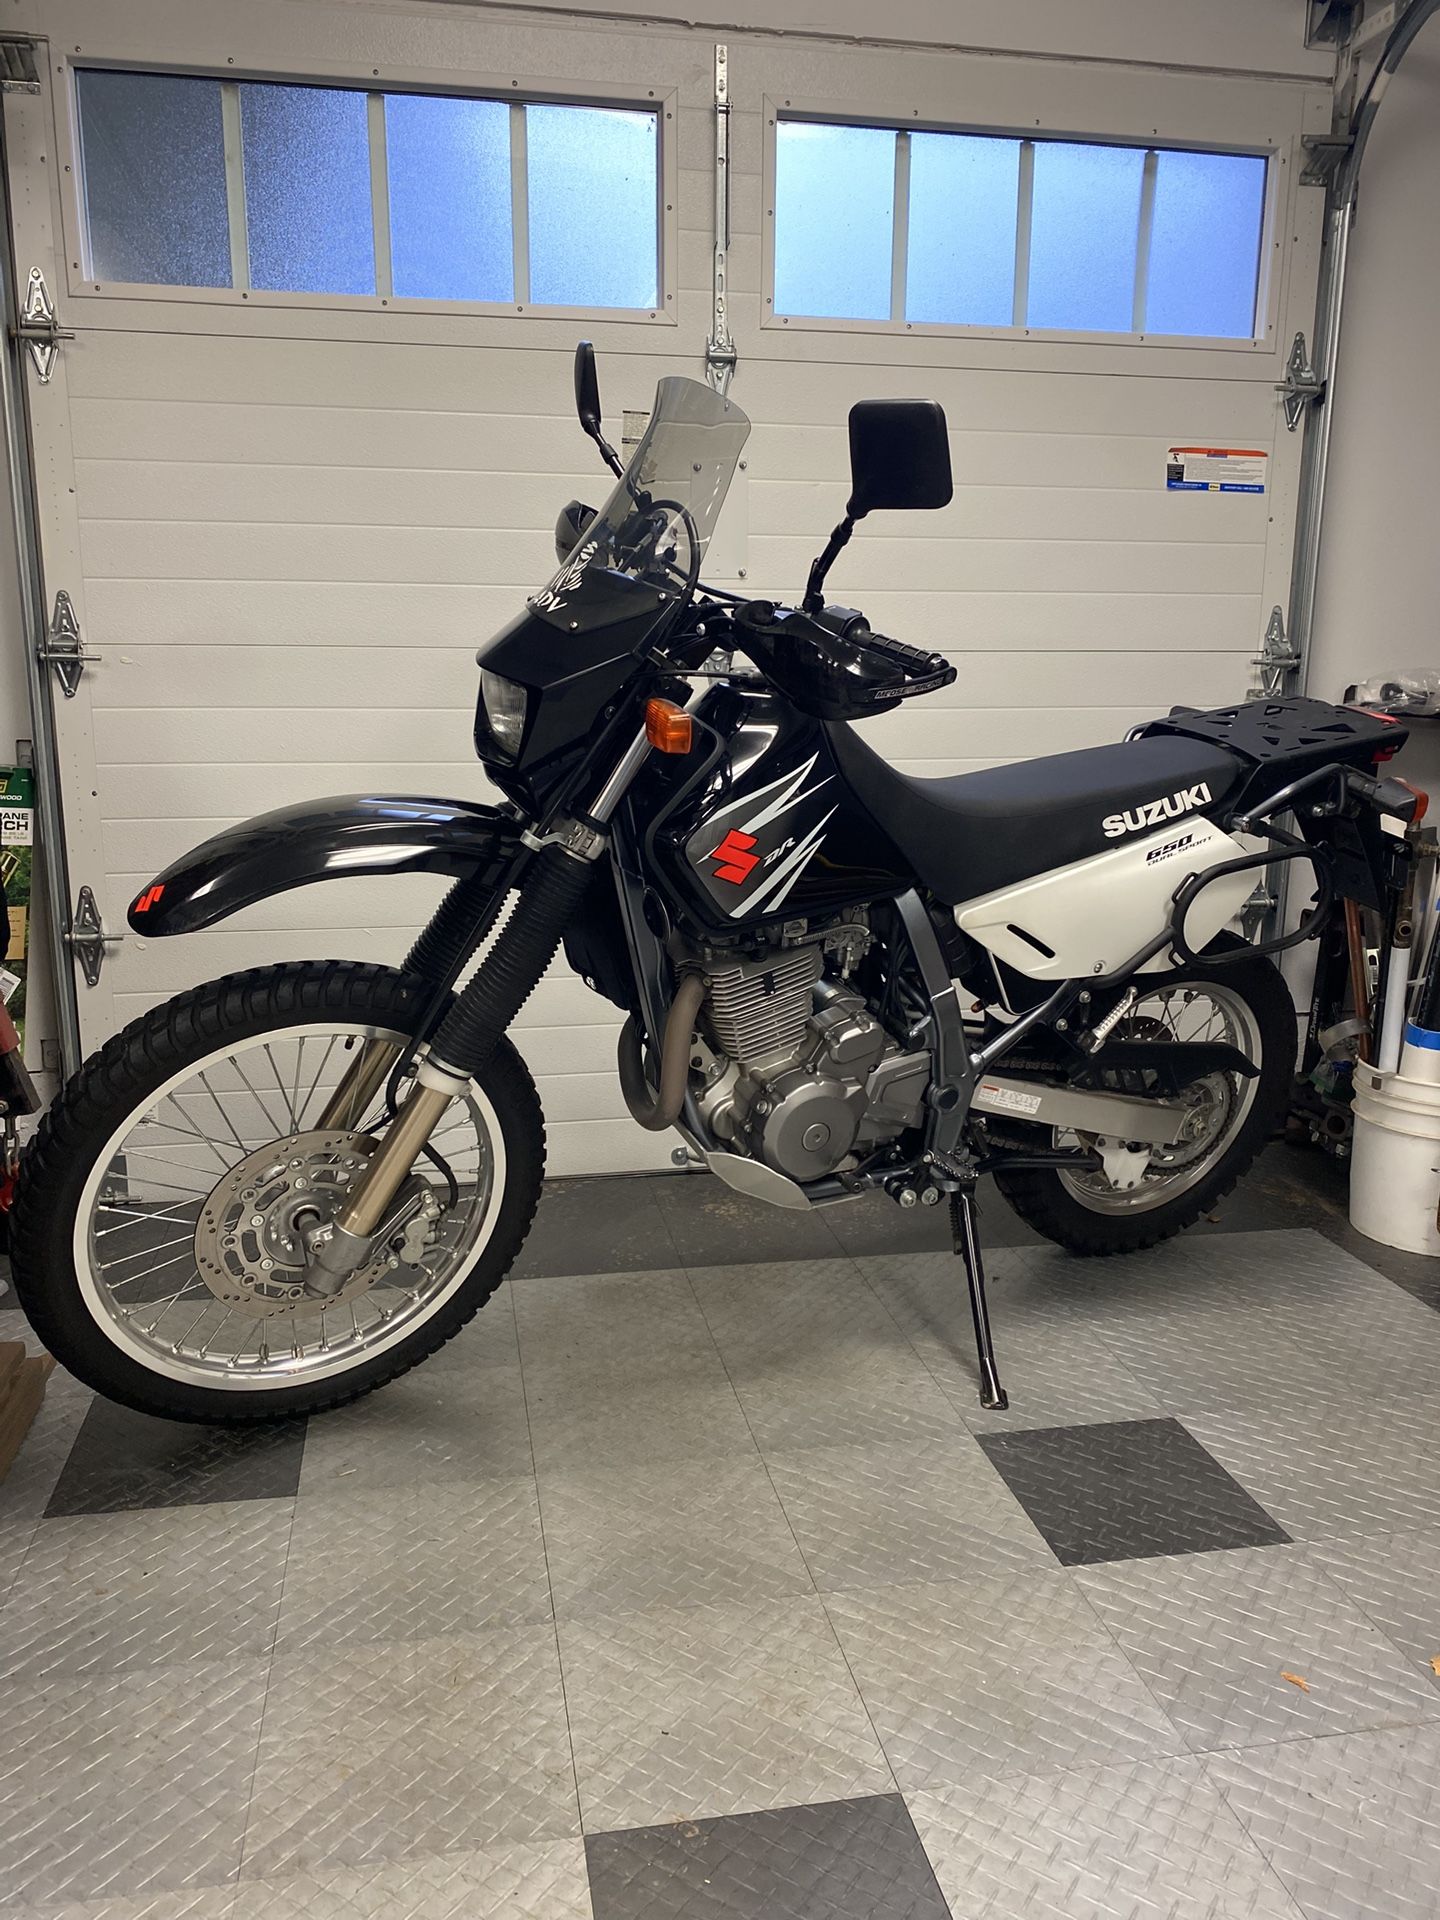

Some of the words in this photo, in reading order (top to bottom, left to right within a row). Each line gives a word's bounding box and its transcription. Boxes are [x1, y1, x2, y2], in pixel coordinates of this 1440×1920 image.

[0, 812, 29, 820] ANE
[1102, 782, 1212, 838] SUZUKI
[763, 836, 797, 868] DR
[1146, 832, 1194, 862] 650
